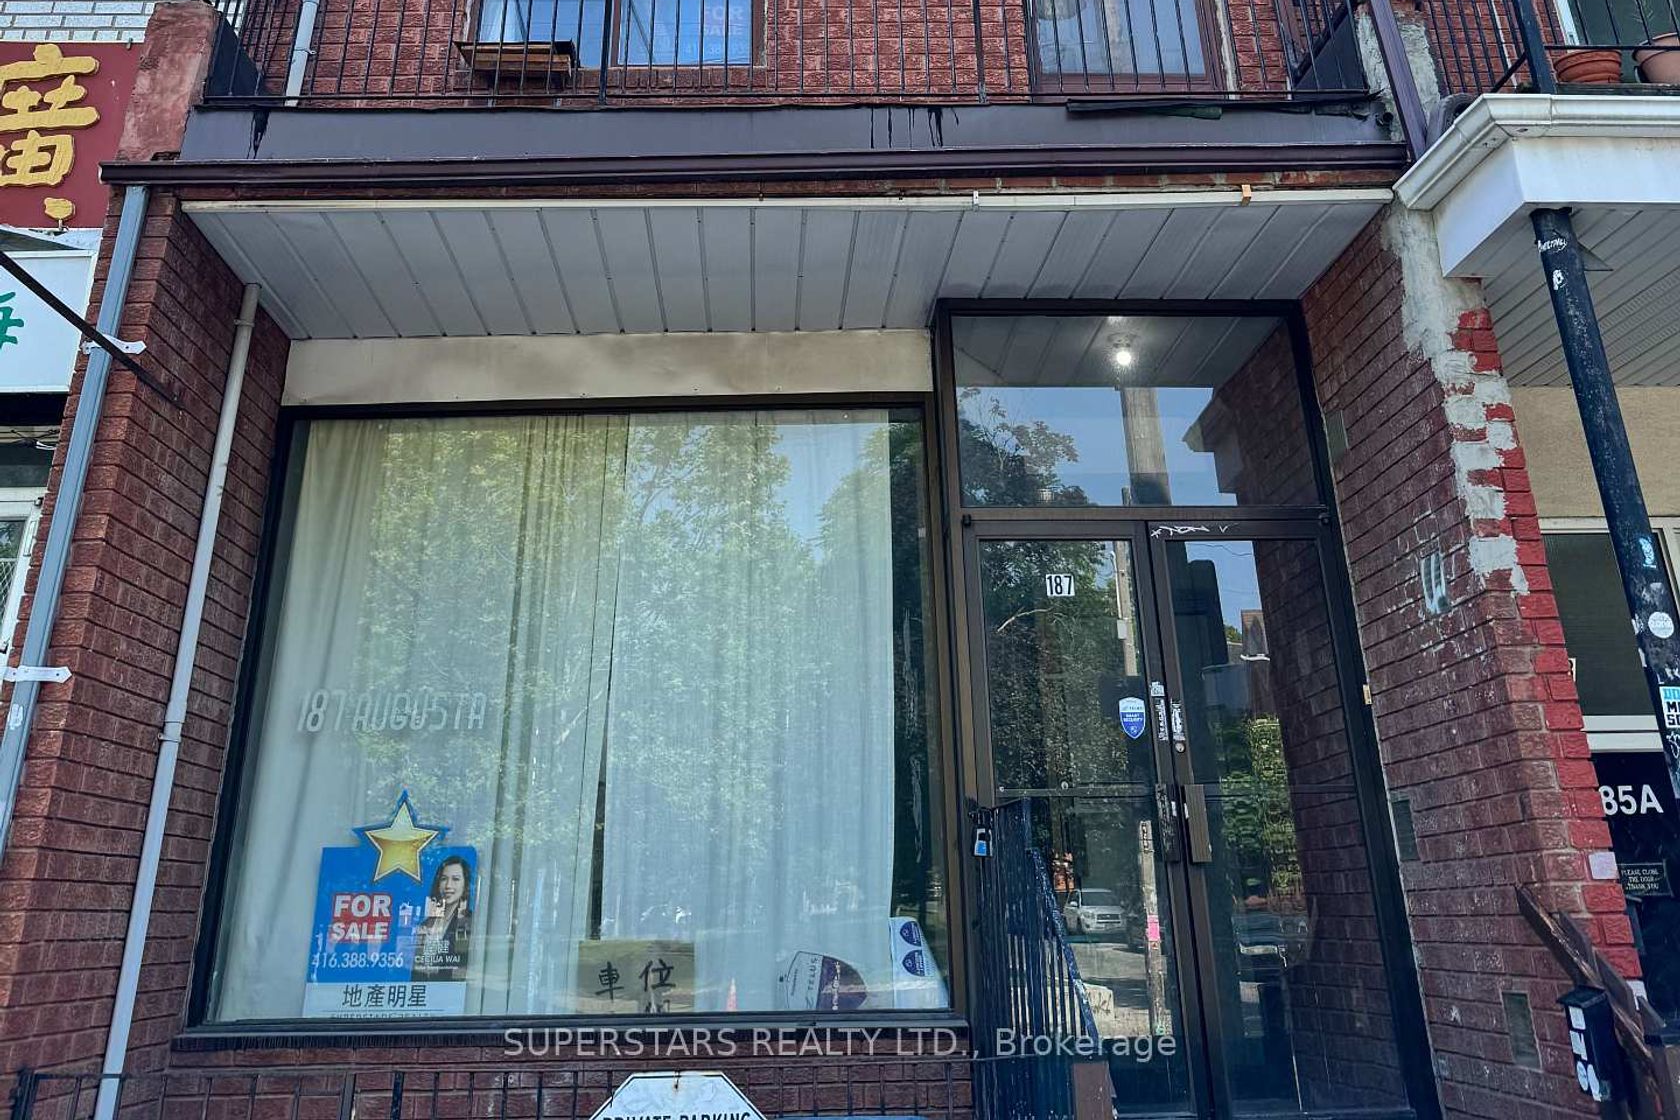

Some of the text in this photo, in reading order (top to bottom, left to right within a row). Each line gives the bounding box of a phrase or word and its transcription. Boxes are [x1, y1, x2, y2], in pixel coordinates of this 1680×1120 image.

[1047, 575, 1072, 595] 187
[298, 689, 487, 732] 187 AUGUSTA
[333, 894, 391, 918] FOR
[330, 921, 389, 941] SALE
[312, 952, 404, 969] 416.388.9356
[594, 958, 677, 1003] 車位
[341, 984, 428, 1008] 地產明星
